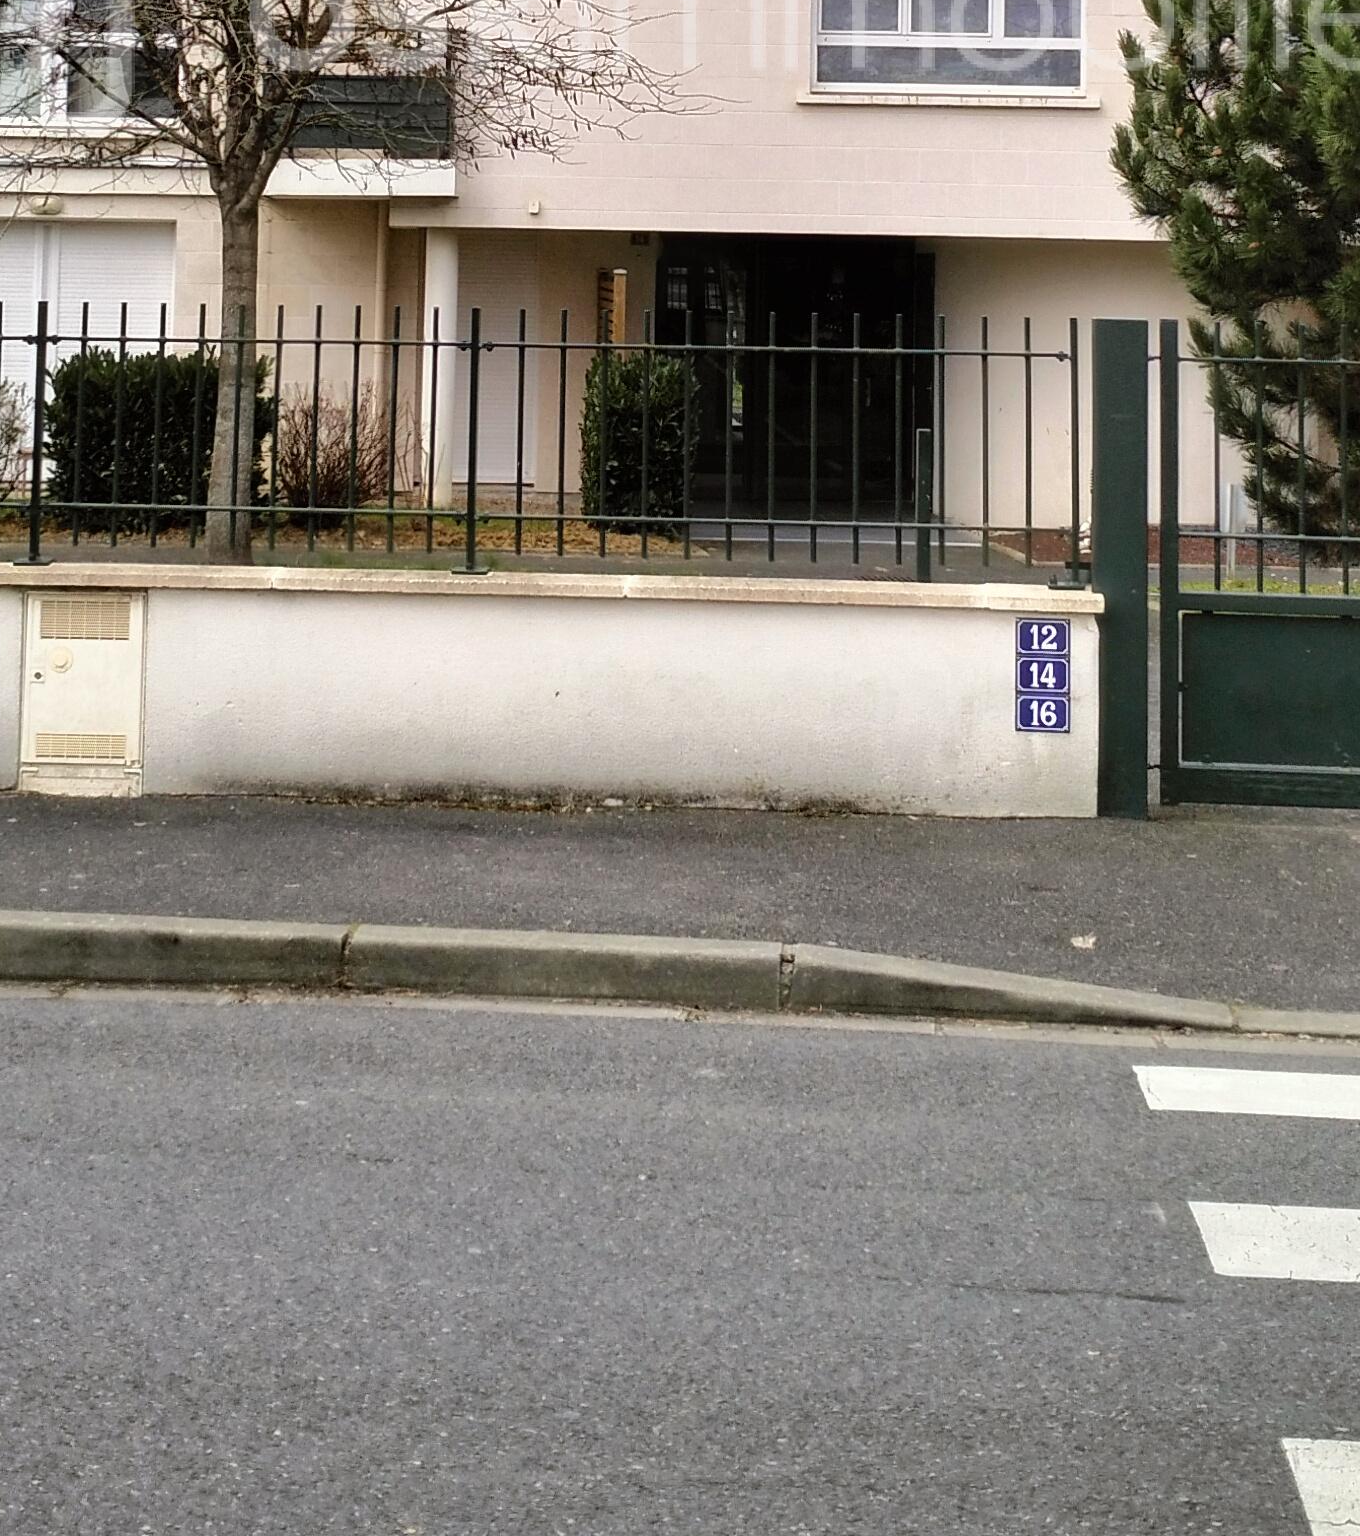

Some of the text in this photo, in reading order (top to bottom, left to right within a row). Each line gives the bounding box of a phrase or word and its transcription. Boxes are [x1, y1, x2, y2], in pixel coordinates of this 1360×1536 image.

[1030, 624, 1058, 650] 12
[1029, 662, 1057, 689] 14
[1029, 700, 1058, 727] 16
